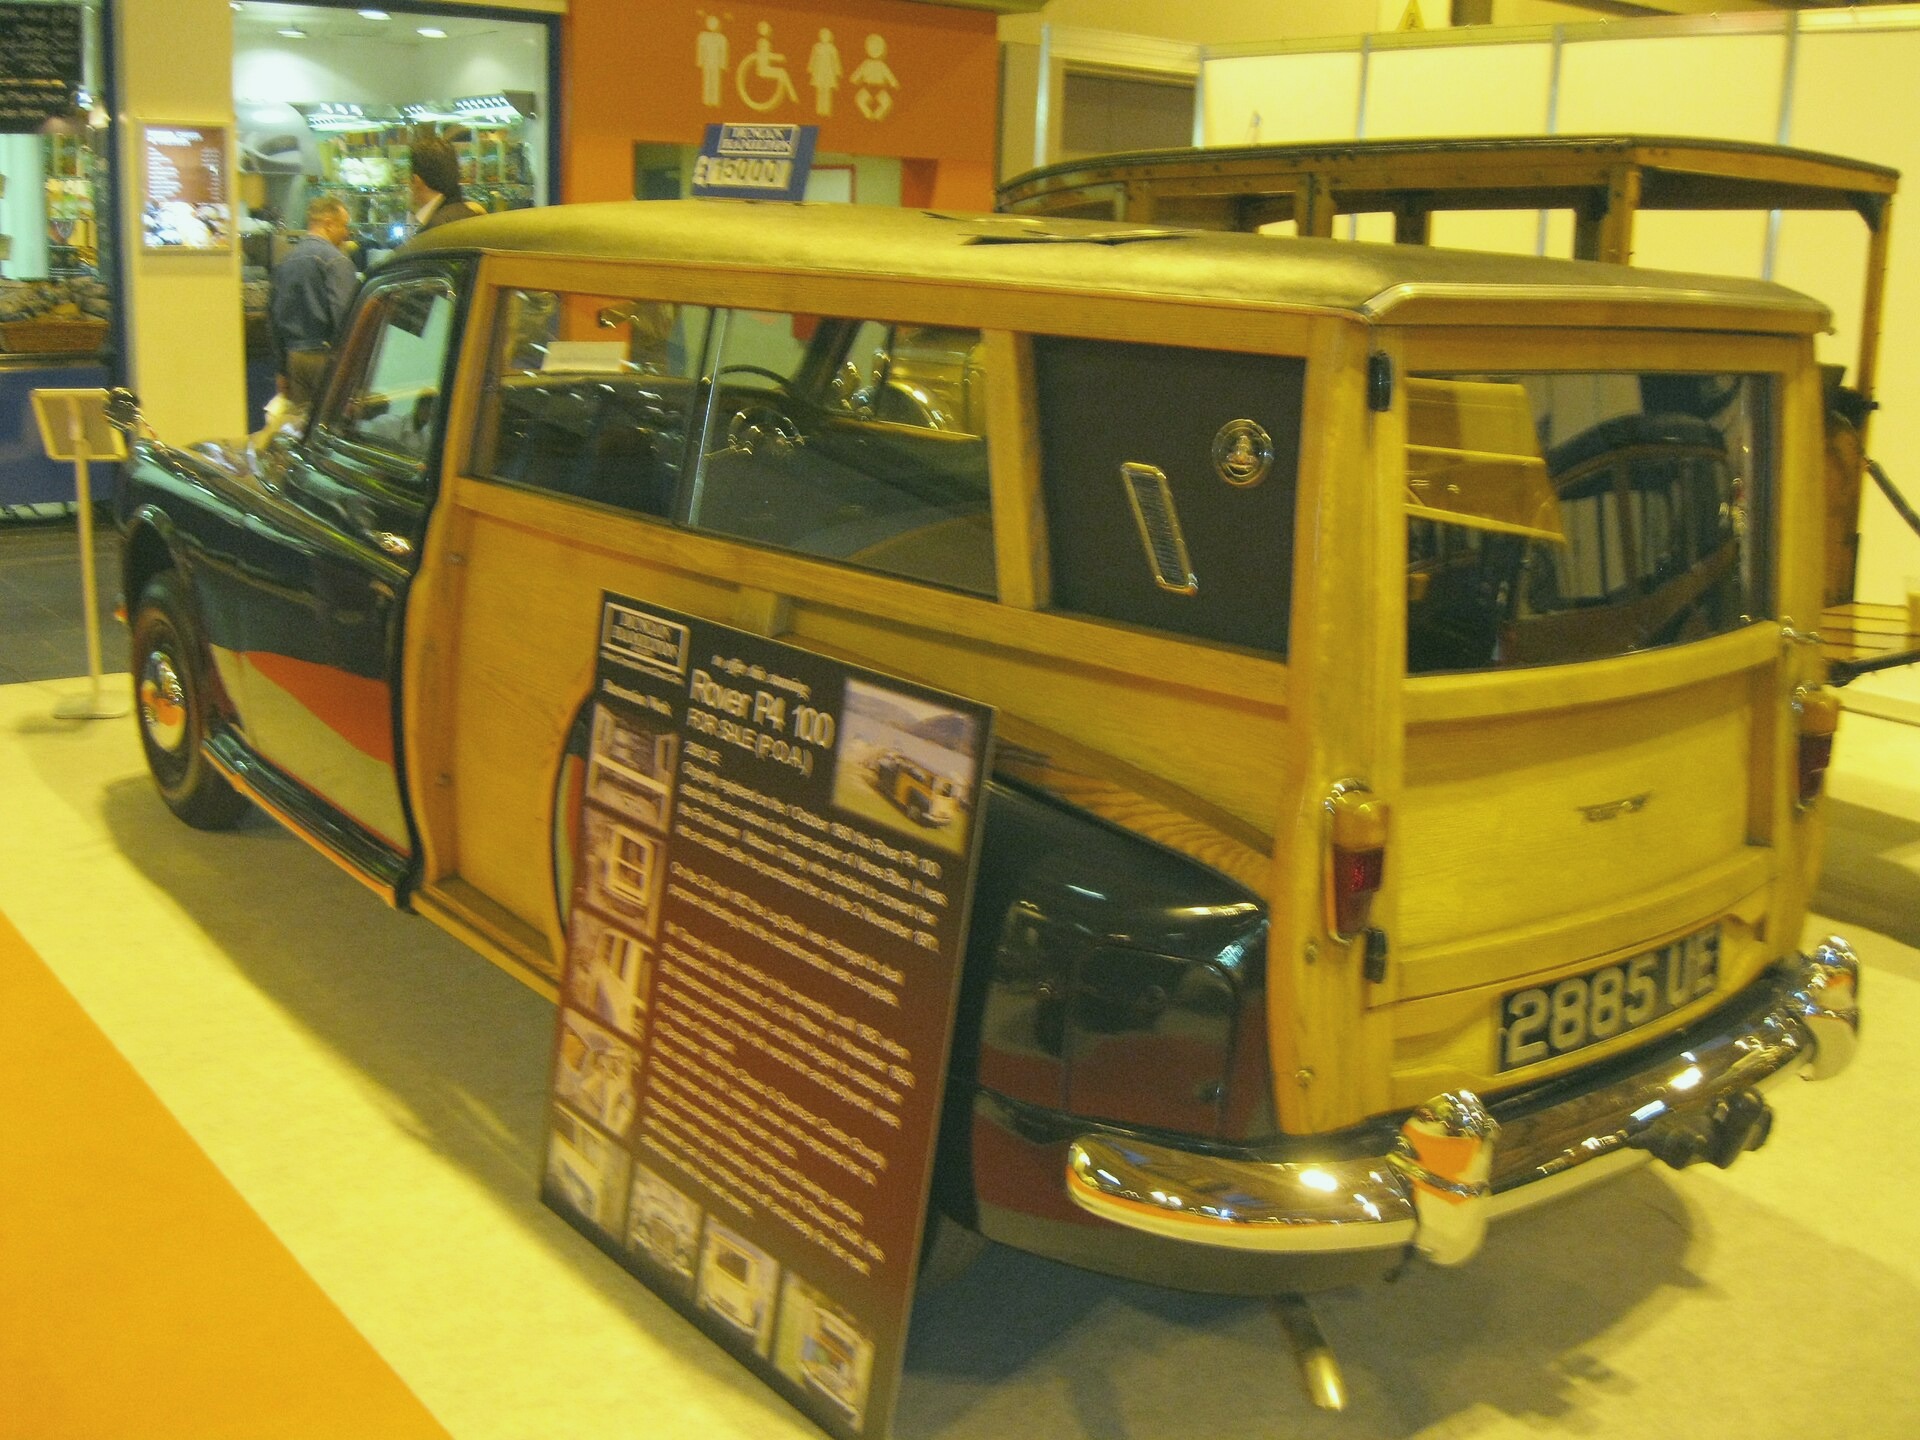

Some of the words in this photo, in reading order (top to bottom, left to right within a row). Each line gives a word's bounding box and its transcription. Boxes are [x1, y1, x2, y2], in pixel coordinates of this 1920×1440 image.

[687, 707, 719, 736] FOR
[717, 719, 757, 752] SALE
[689, 668, 753, 721] Rover
[753, 690, 786, 733] P4
[791, 703, 836, 750] 100
[1507, 950, 1660, 1064] 2885
[1667, 931, 1717, 1006] UE
